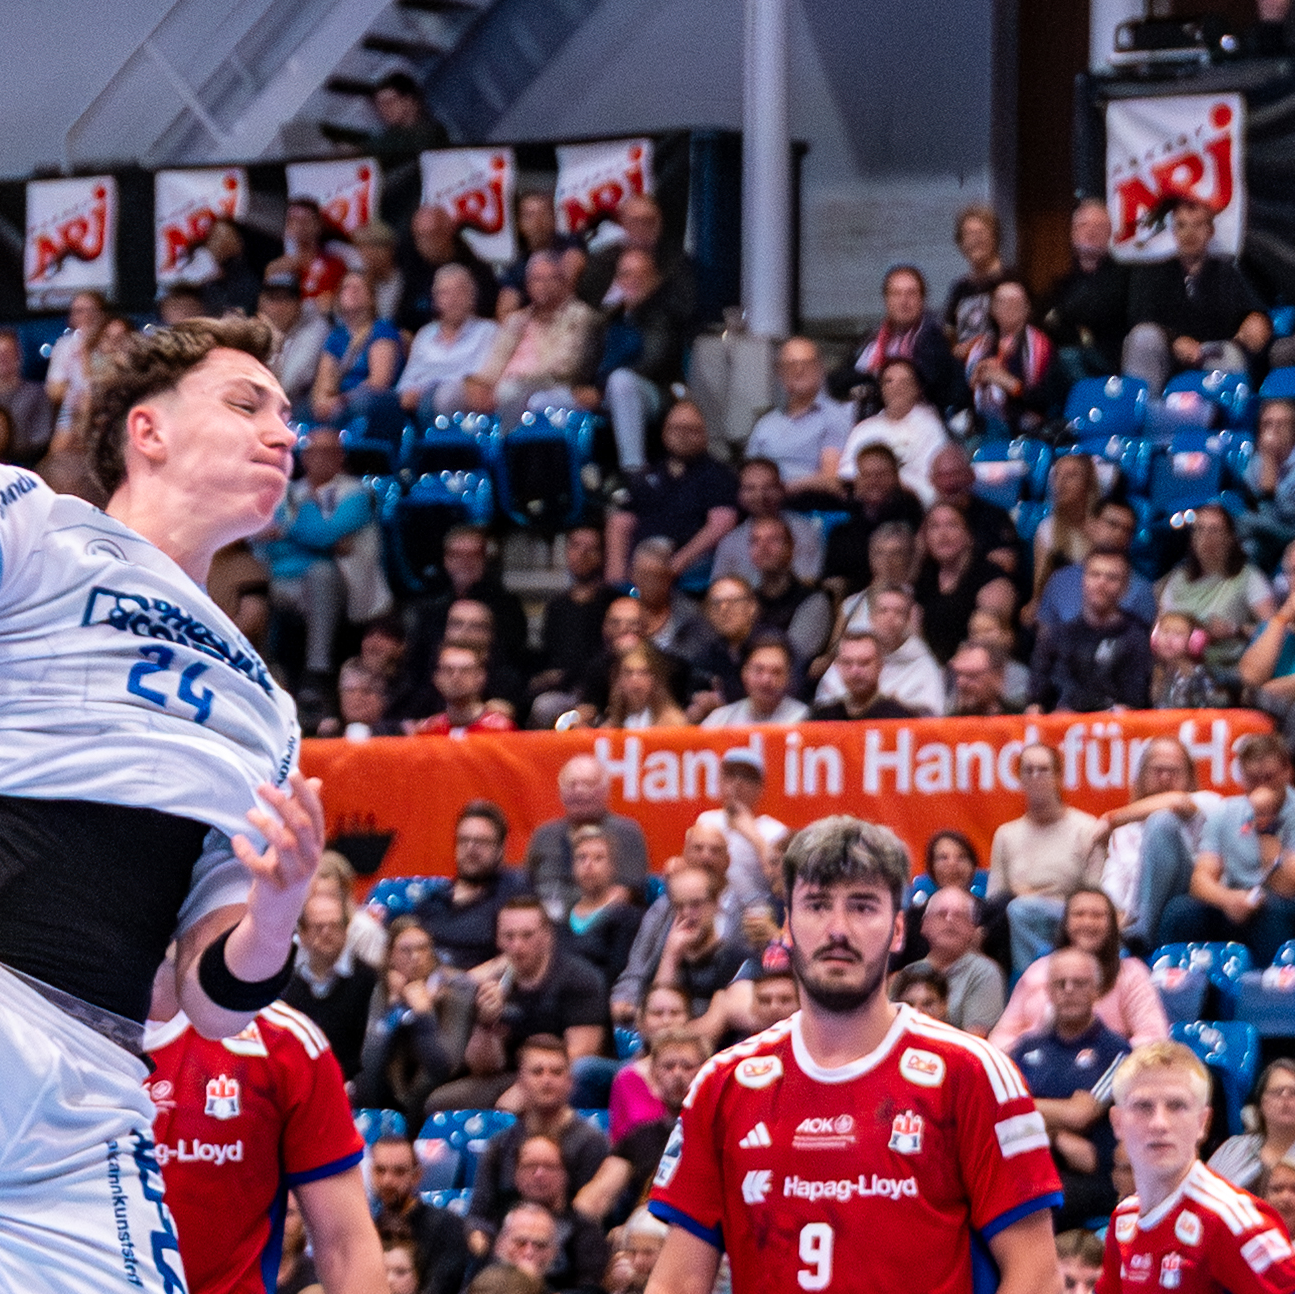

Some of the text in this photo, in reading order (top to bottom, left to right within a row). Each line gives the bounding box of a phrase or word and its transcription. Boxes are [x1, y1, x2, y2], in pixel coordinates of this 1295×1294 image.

[447, 155, 506, 234] RJ
[1112, 102, 1233, 244] NRJ
[26, 185, 106, 283] NRJ
[127, 643, 214, 724] 24
[595, 732, 764, 801] Han
[783, 731, 843, 797] in
[906, 1054, 939, 1074] Dole
[154, 1138, 244, 1167] g-Lloyd
[795, 1116, 835, 1133] AOK
[782, 1174, 919, 1203] Hapag-Lloyd
[797, 1221, 836, 1292] 9
